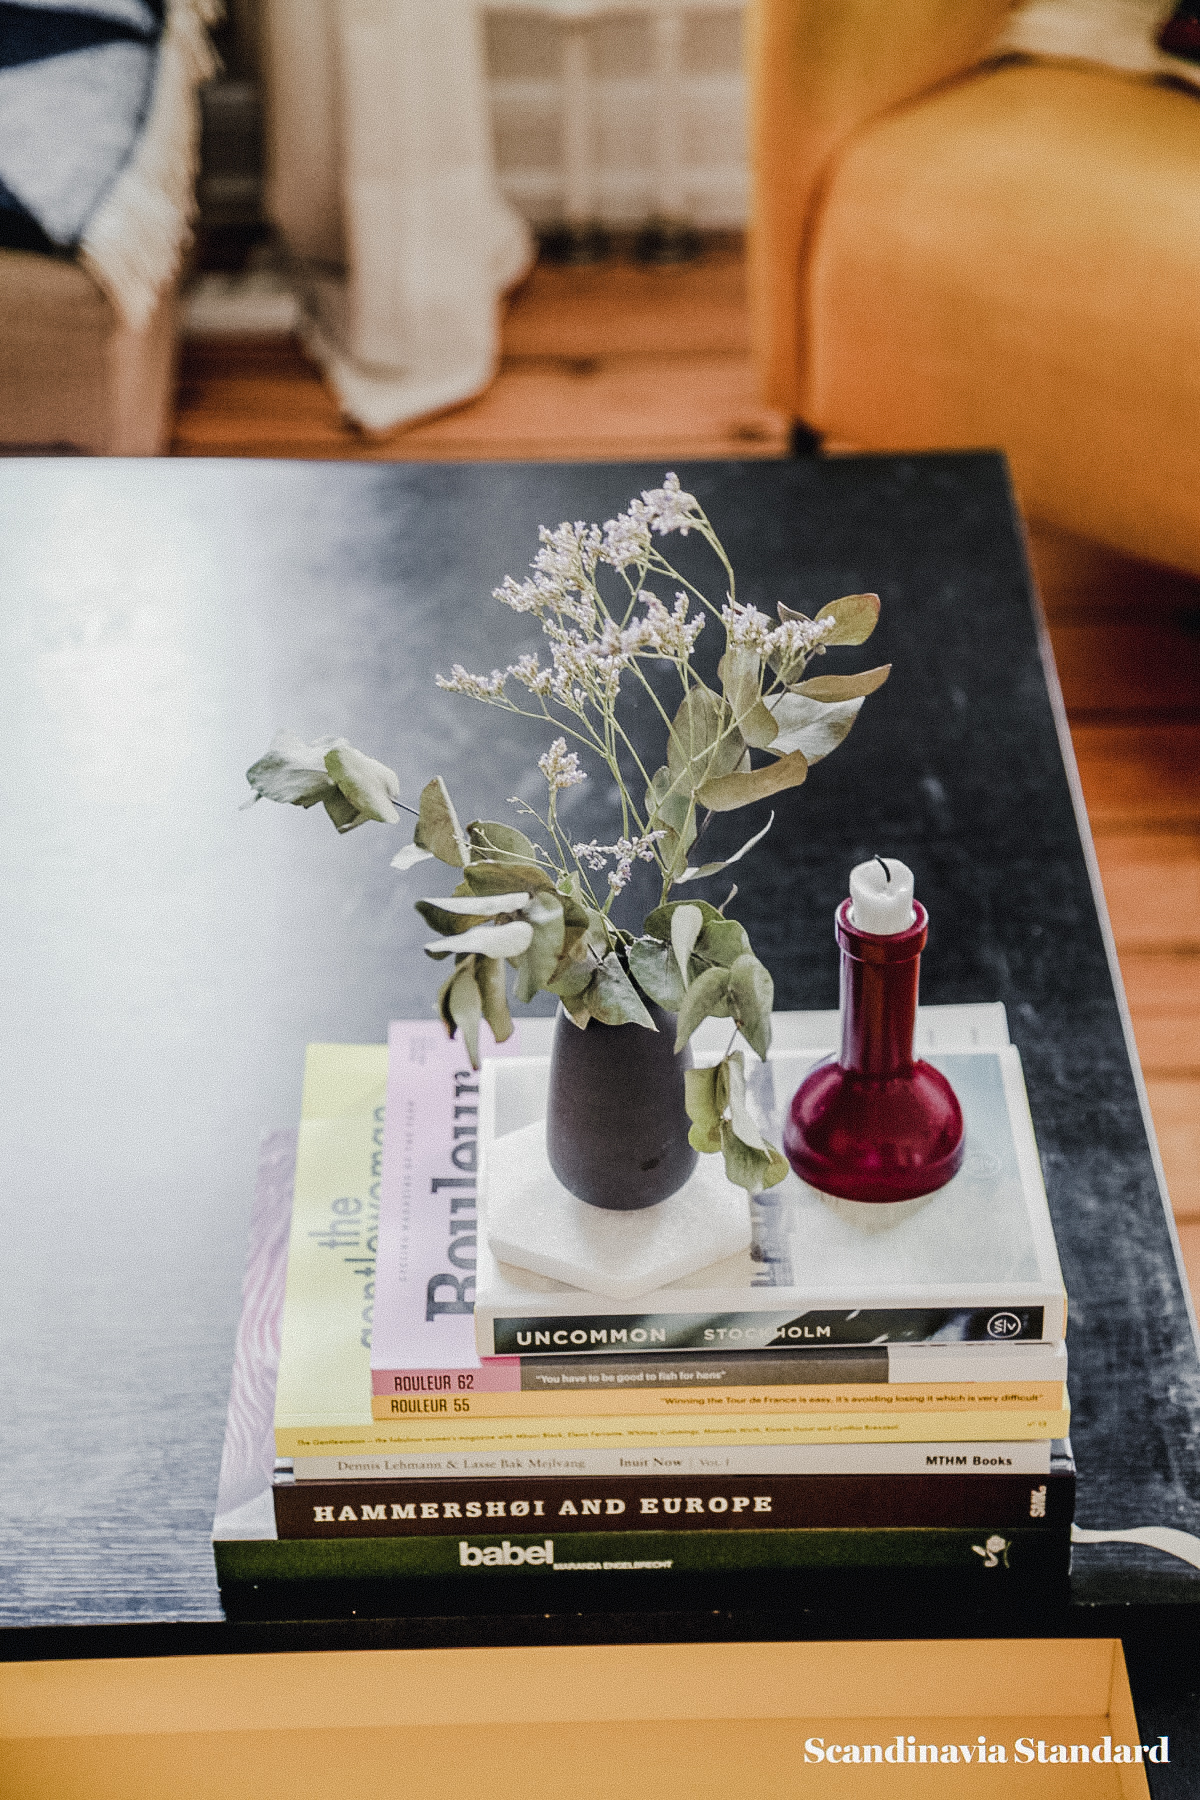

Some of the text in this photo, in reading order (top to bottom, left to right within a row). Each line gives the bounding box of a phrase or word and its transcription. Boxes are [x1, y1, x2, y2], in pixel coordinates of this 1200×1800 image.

[308, 1197, 362, 1249] the
[516, 1328, 667, 1346] UNCOMMON
[394, 1374, 475, 1391] ROULEUR 62
[562, 1374, 587, 1383] have
[588, 1374, 599, 1383] to
[601, 1373, 615, 1383] be
[616, 1372, 644, 1384] good
[645, 1372, 657, 1381] to
[658, 1372, 678, 1381] fish
[679, 1371, 694, 1380] for
[391, 1398, 470, 1413] ROULEUR 55
[337, 1460, 381, 1471] Dennis
[384, 1460, 441, 1471] Lehmann
[446, 1460, 458, 1469] &
[463, 1459, 496, 1469] Lasse
[500, 1458, 523, 1469] Bak
[653, 1457, 682, 1466] Now
[926, 1455, 1012, 1466] MTHM Books
[313, 1496, 773, 1522] HAMMERSHØI AND EUROPE
[458, 1540, 554, 1567] babel
